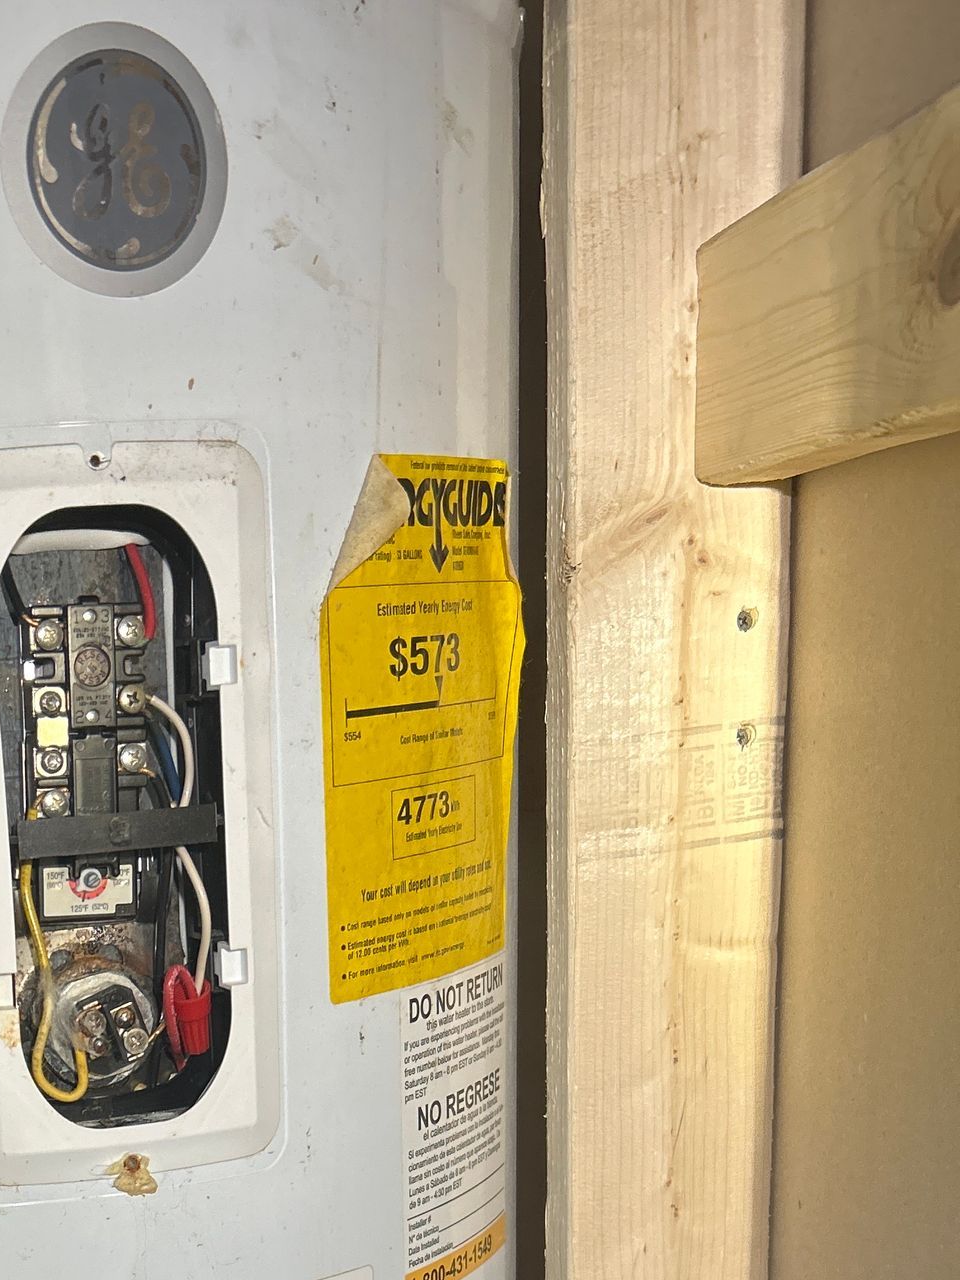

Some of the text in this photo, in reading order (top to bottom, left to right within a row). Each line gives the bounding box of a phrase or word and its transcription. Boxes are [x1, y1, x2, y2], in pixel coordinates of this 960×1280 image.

[377, 598, 473, 616] Estimated Yearly Energy Cost
[389, 632, 460, 682] $573
[76, 710, 84, 724] 2
[344, 731, 361, 742] $554
[397, 790, 450, 825] 4773
[361, 889, 377, 903] Your
[380, 885, 394, 899] cost
[395, 880, 407, 895] will
[409, 875, 431, 894] depend
[348, 970, 358, 980] For
[360, 968, 375, 977] more
[408, 954, 418, 965] visit
[409, 963, 503, 1024] DO NOT RETURN
[426, 1007, 471, 1031] this water heater
[405, 1087, 427, 1104] pm EST
[417, 1067, 500, 1131] NO REGRESE
[408, 1236, 440, 1256] Date Installed
